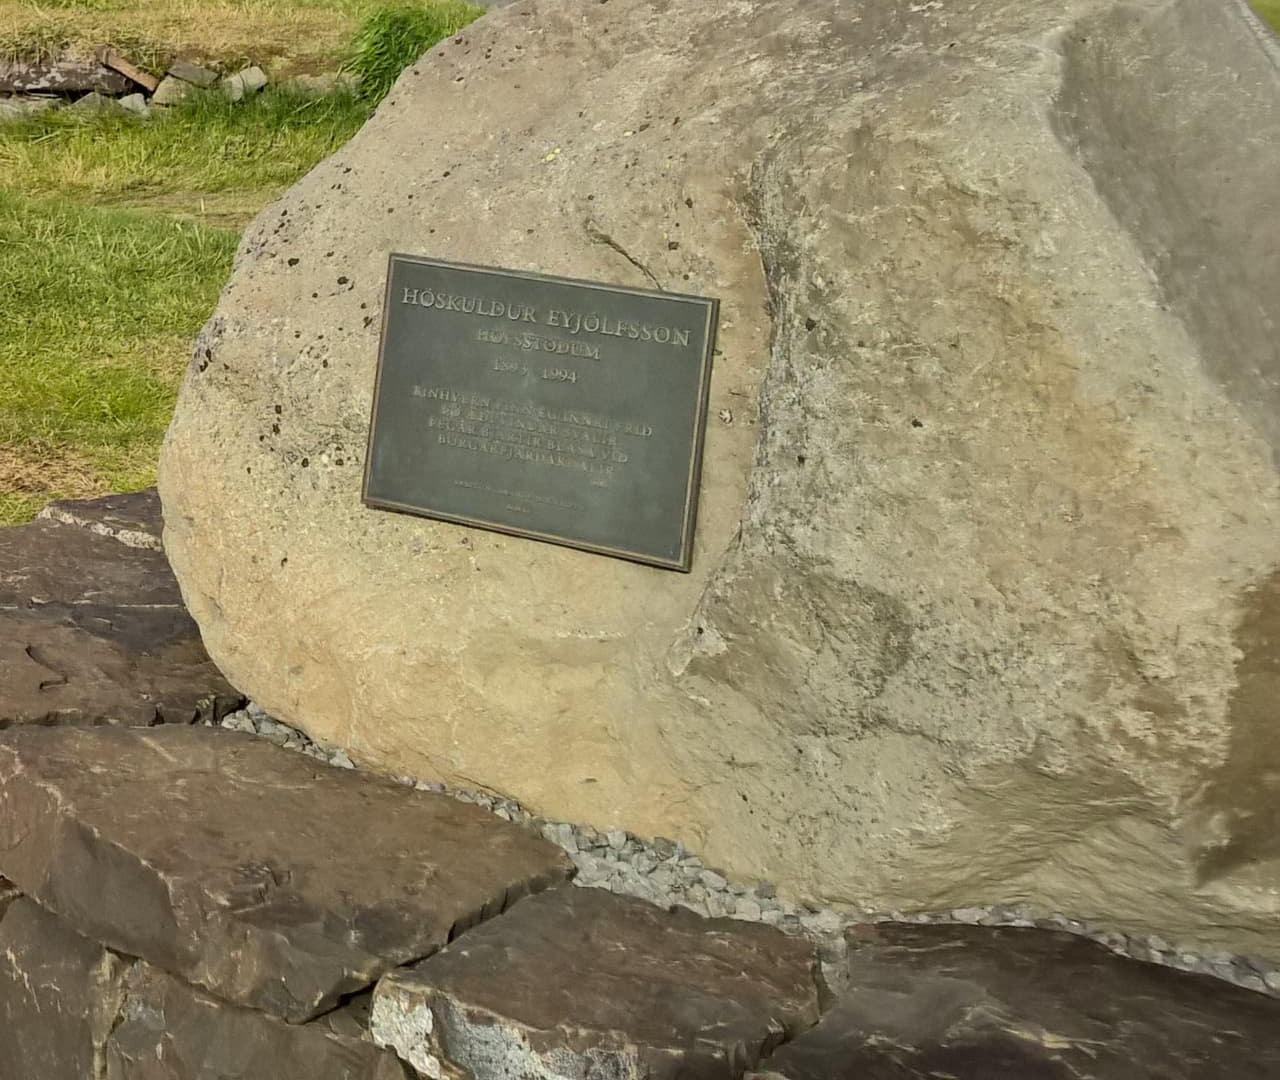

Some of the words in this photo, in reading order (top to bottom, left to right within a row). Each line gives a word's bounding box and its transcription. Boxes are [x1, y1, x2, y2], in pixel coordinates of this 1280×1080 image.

[402, 286, 537, 323] HÖSKULDUR
[546, 308, 690, 347] EYJÓLFSSON
[541, 367, 577, 384] 1994
